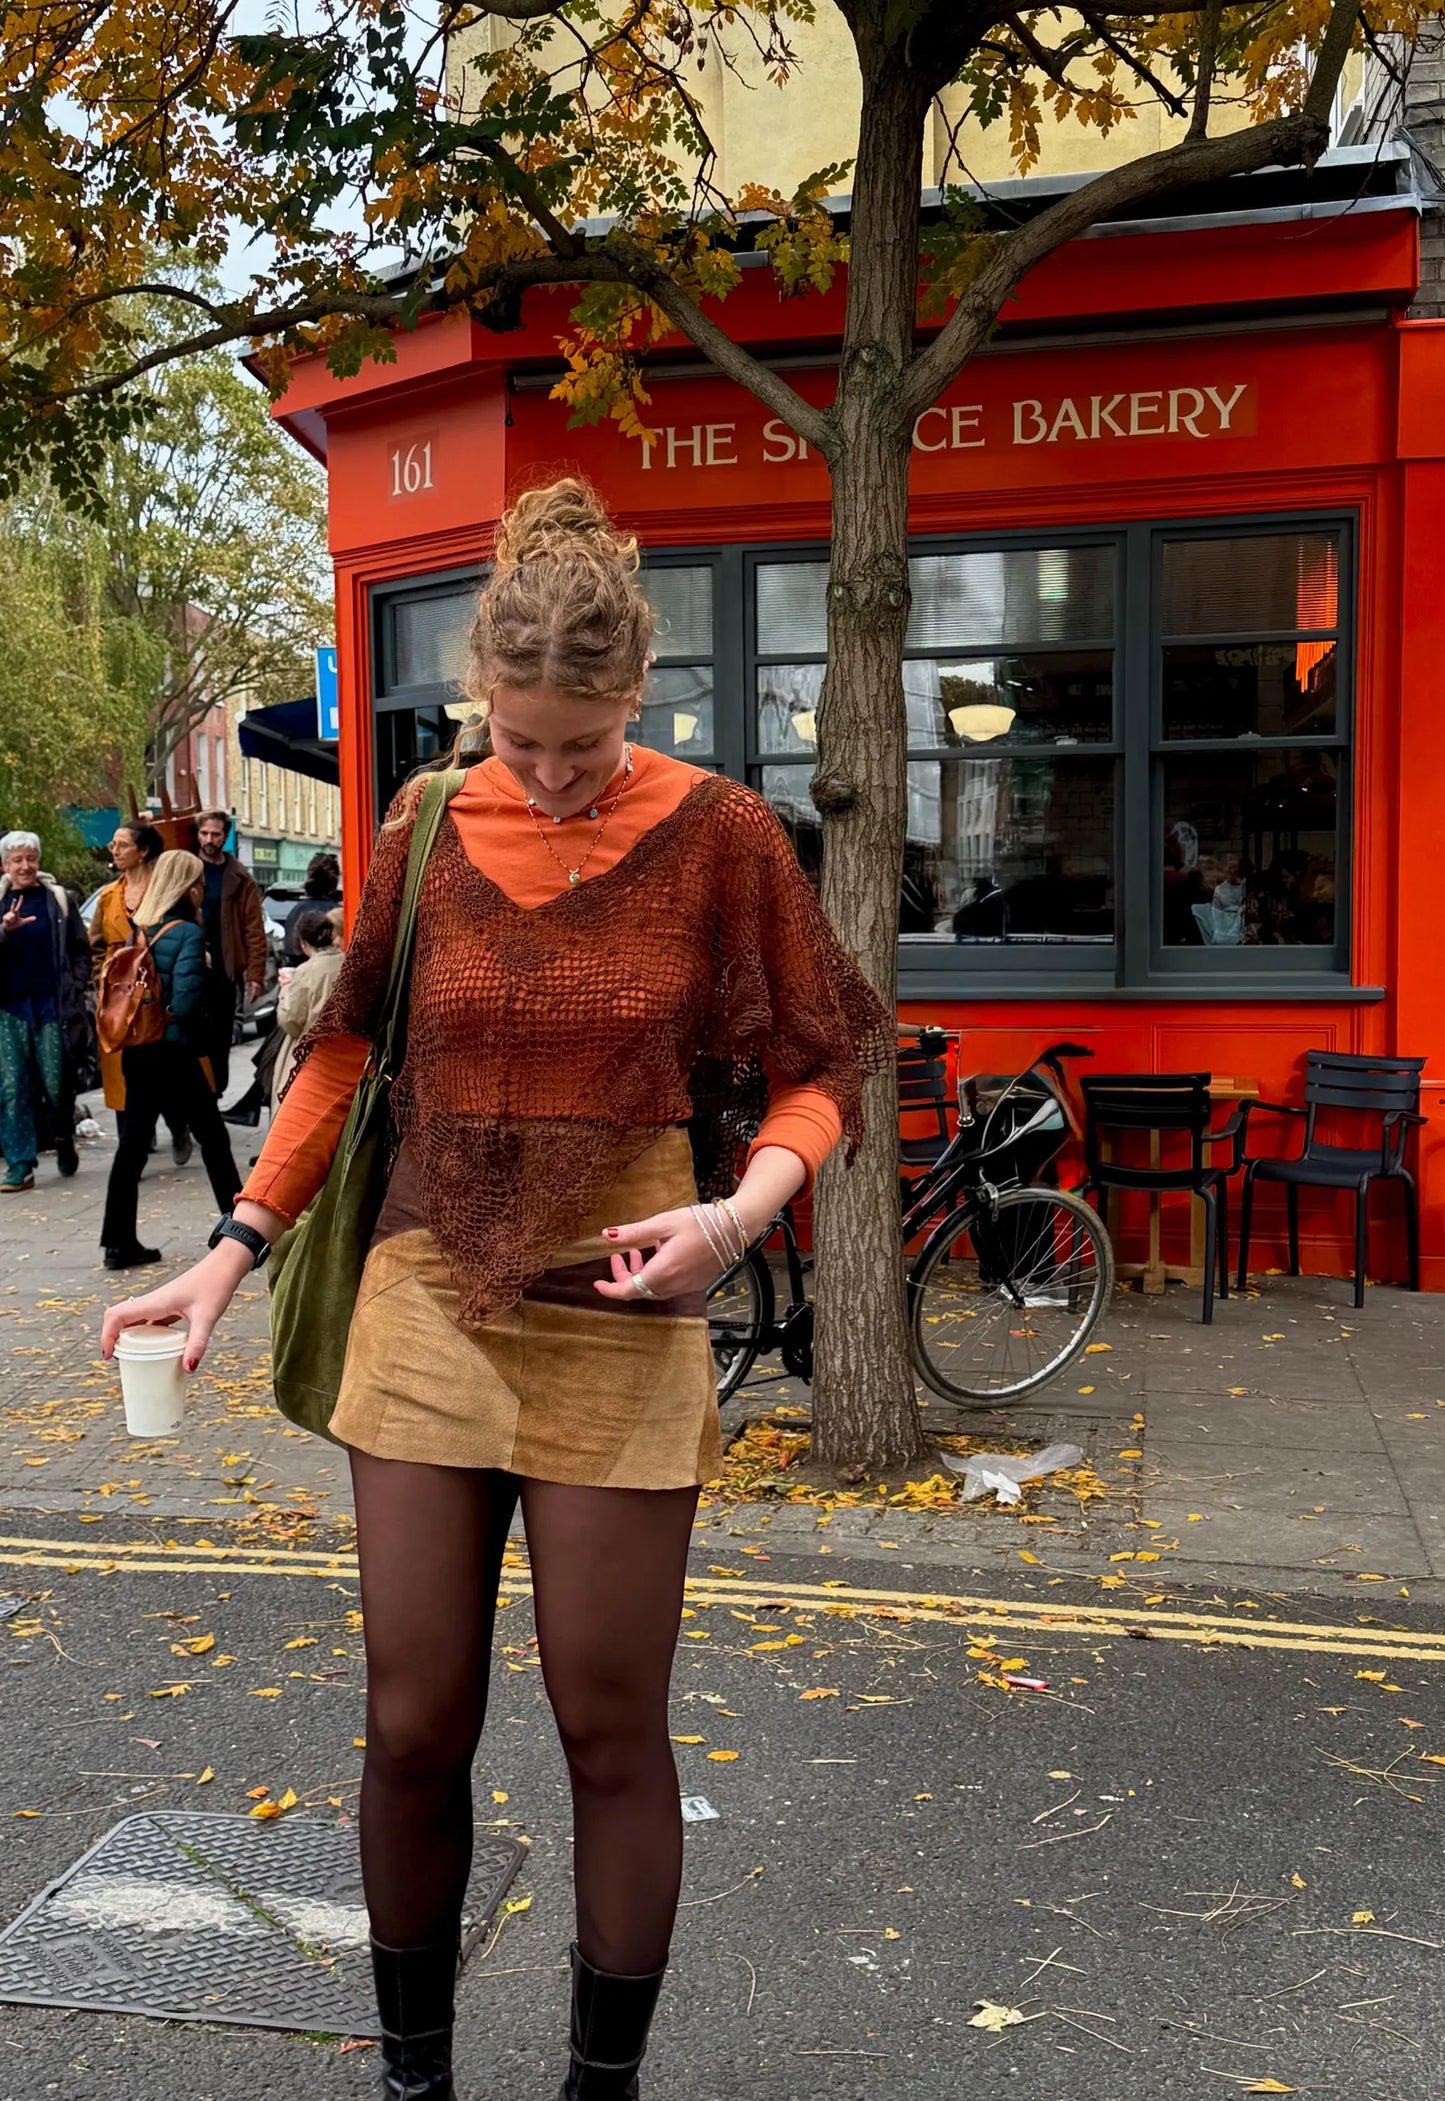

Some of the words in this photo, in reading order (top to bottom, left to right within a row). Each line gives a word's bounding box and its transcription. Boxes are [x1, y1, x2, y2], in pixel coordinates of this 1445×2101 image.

[638, 423, 738, 470] THE
[1012, 384, 1248, 445] BAKERY
[392, 440, 434, 496] 161
